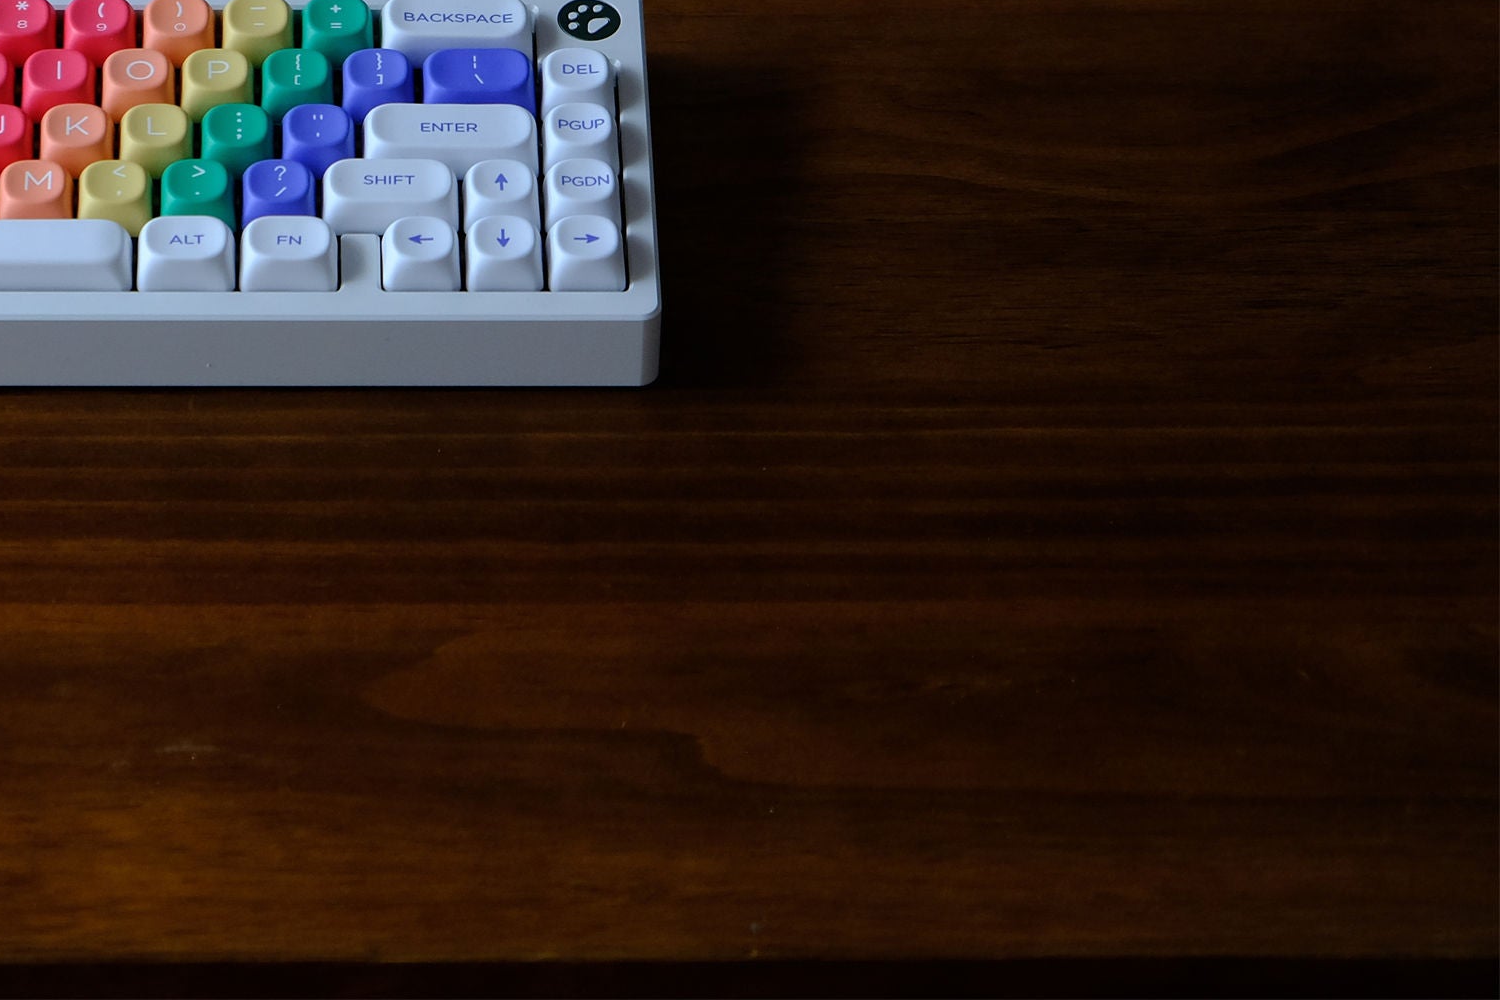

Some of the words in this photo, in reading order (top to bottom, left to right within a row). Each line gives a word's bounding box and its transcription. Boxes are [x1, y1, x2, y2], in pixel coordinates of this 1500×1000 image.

[404, 12, 513, 24] BACKSPACE
[17, 20, 28, 29] 8
[96, 23, 107, 31] 9
[56, 61, 62, 79] I
[126, 61, 154, 80] O
[208, 60, 229, 79] P
[562, 63, 598, 75] DEL
[66, 116, 89, 135] K
[147, 116, 167, 135] L
[420, 122, 478, 132] ENTER
[558, 118, 604, 130] PGUP
[25, 171, 51, 190] M
[363, 174, 415, 185] SHIFT
[561, 174, 610, 187] PGDN
[169, 235, 204, 245] ALT
[277, 235, 302, 244] FN
